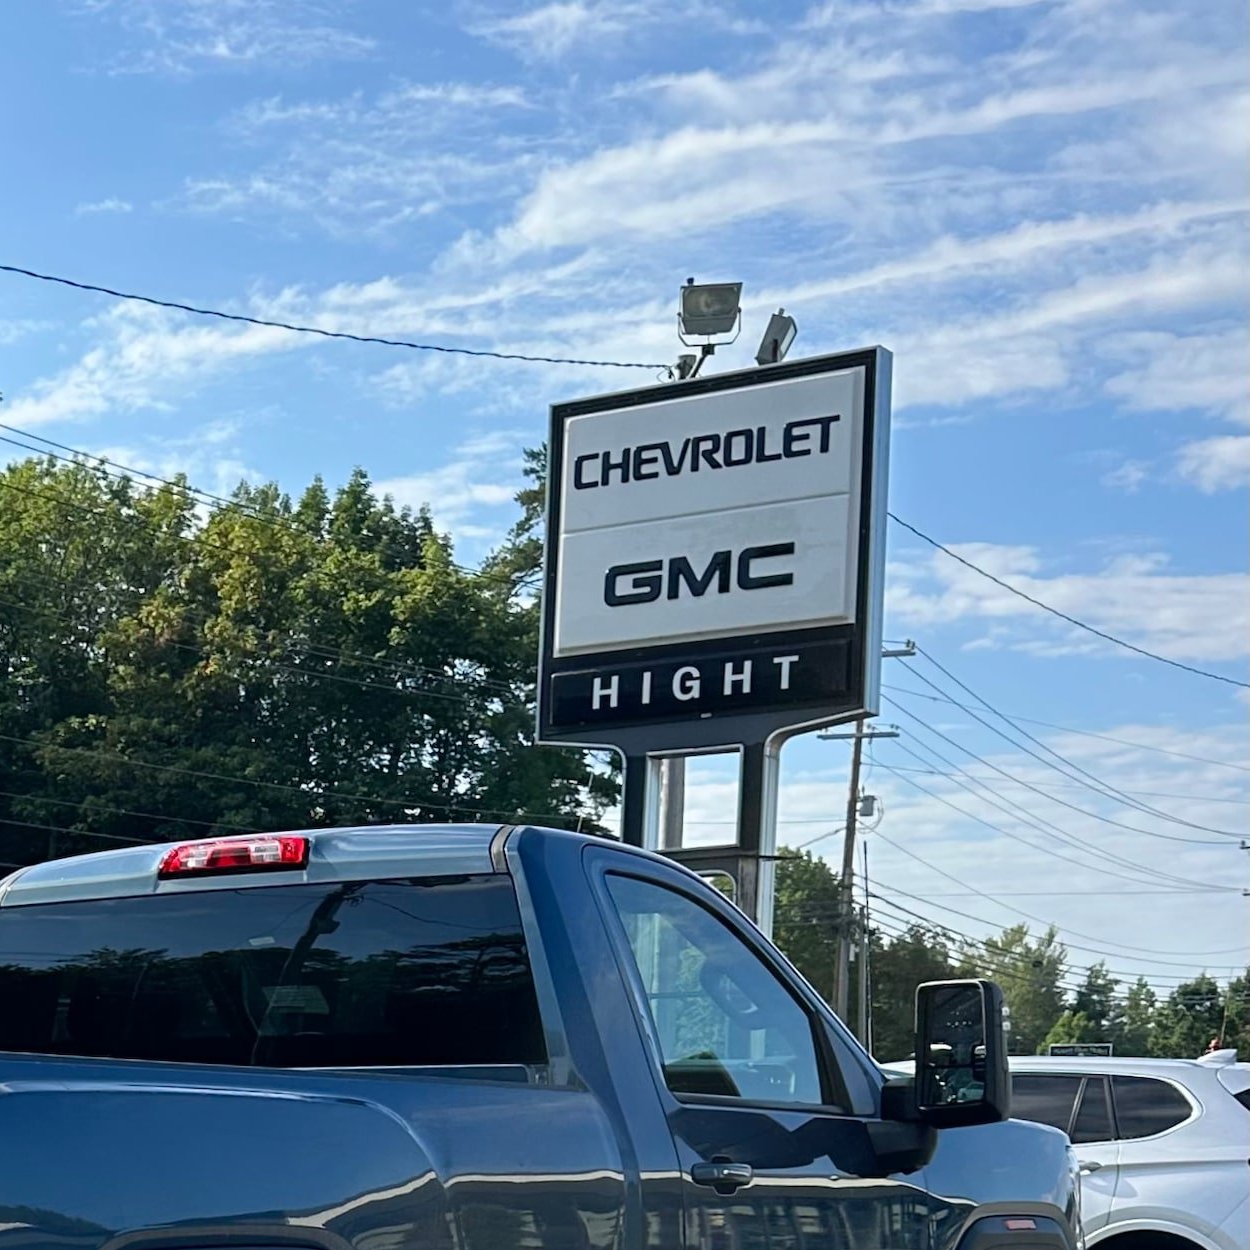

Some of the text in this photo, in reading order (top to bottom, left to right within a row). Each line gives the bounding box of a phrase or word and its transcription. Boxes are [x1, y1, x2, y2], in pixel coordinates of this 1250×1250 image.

[574, 414, 840, 490] CHEVROLET
[603, 541, 795, 607] GMC
[591, 655, 799, 710] HIGHT
